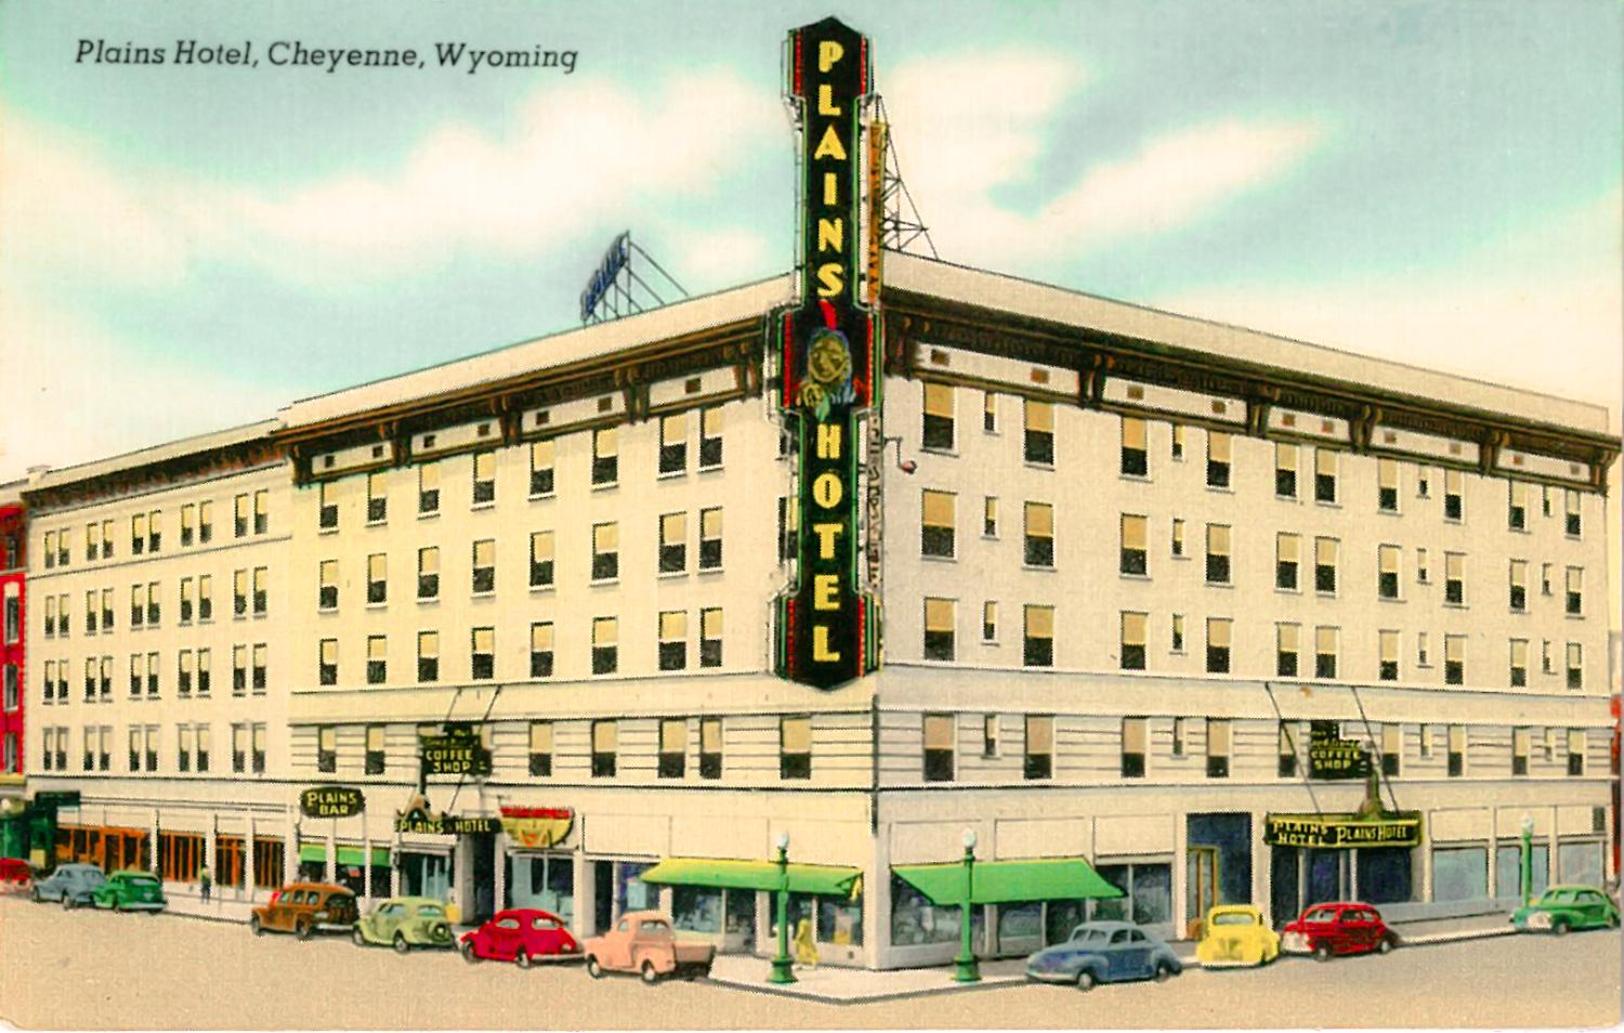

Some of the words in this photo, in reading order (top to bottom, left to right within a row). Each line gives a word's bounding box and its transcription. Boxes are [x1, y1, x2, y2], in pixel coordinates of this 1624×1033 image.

[814, 40, 847, 297] PLAINS
[812, 423, 843, 663] HOTEL
[425, 749, 473, 761] COFFEE
[1311, 750, 1361, 760] COFFEE
[432, 761, 472, 772] SHOP
[1314, 760, 1352, 770] SHOP
[306, 791, 357, 807] PLAINS
[319, 804, 349, 815] BAR
[400, 820, 445, 834] PLAINS
[454, 819, 491, 832] HOTEL
[1336, 825, 1376, 847] PLAINS
[1377, 824, 1408, 841] HOTEL
